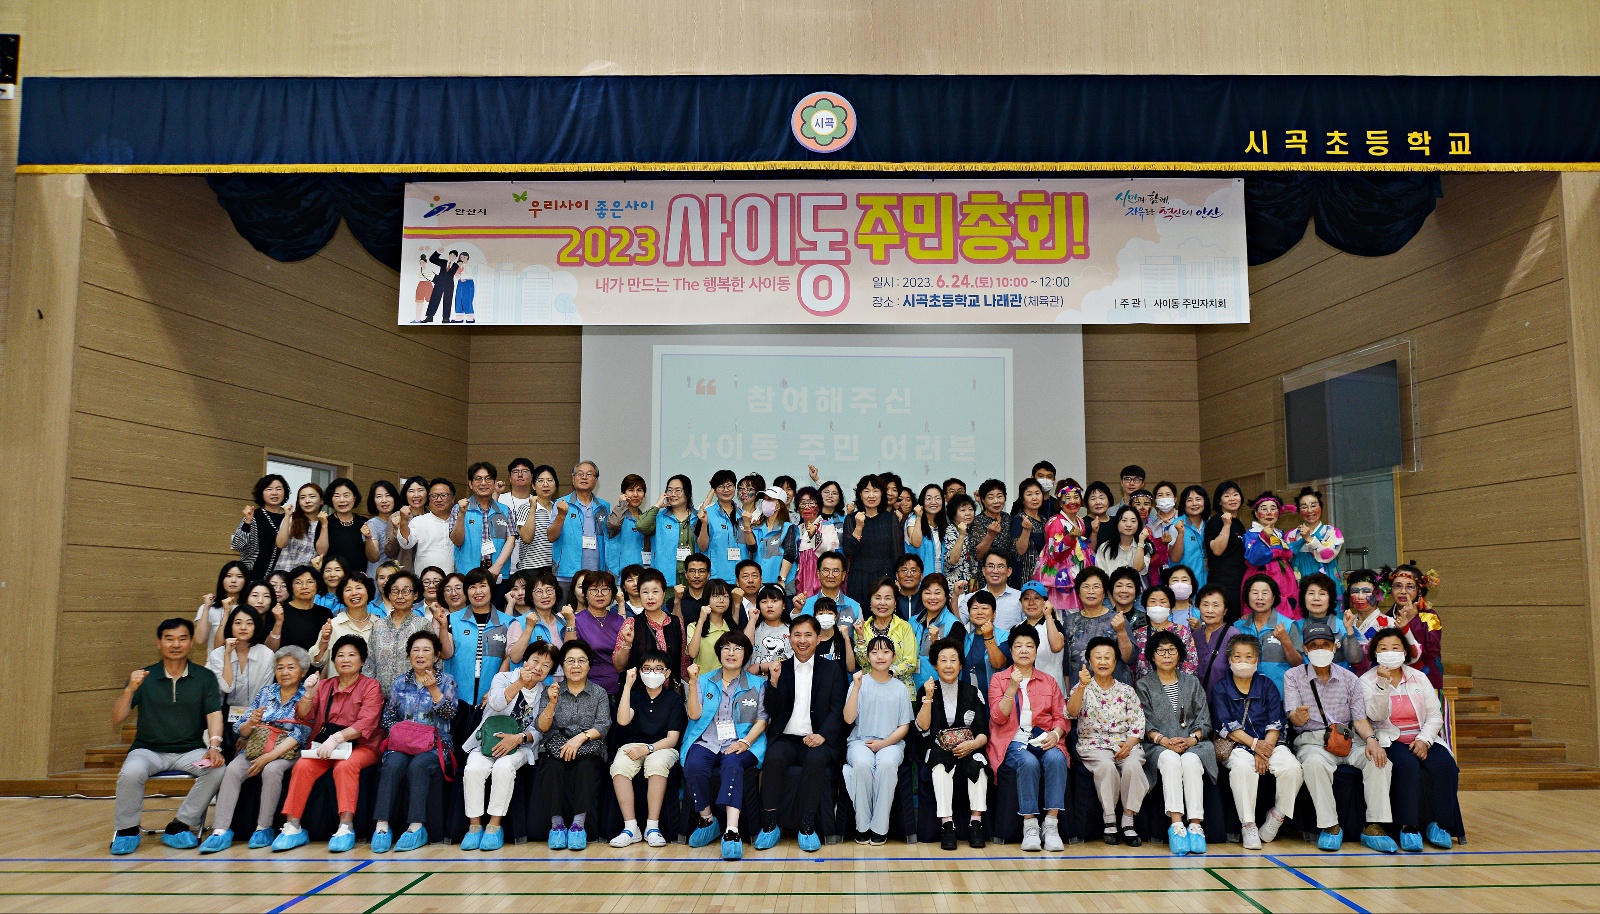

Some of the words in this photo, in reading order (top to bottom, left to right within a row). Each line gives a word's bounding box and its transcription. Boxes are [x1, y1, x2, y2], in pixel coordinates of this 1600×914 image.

[815, 117, 834, 128] 시곡
[1244, 130, 1472, 156] 시곡초등학교
[454, 208, 487, 216] 안산시
[528, 199, 589, 218] 우리사이
[595, 199, 655, 219] 좋은사이
[1195, 207, 1224, 219] 안산
[557, 226, 660, 266] 2023
[663, 193, 851, 317] 사이동
[854, 190, 1090, 265] 주민총회!
[595, 277, 624, 293] 내가
[627, 277, 669, 293] 만드는
[673, 277, 699, 291] The
[703, 276, 745, 292] 행복한
[748, 276, 791, 292] 사이동
[902, 294, 980, 308] 시곡초등학교
[1153, 298, 1180, 309] 사이동
[1182, 298, 1227, 309] 주민자치회
[747, 386, 912, 415] 참여해주신
[681, 433, 778, 461] 사이동
[798, 434, 860, 461] 주민
[881, 434, 977, 462] 여러분
